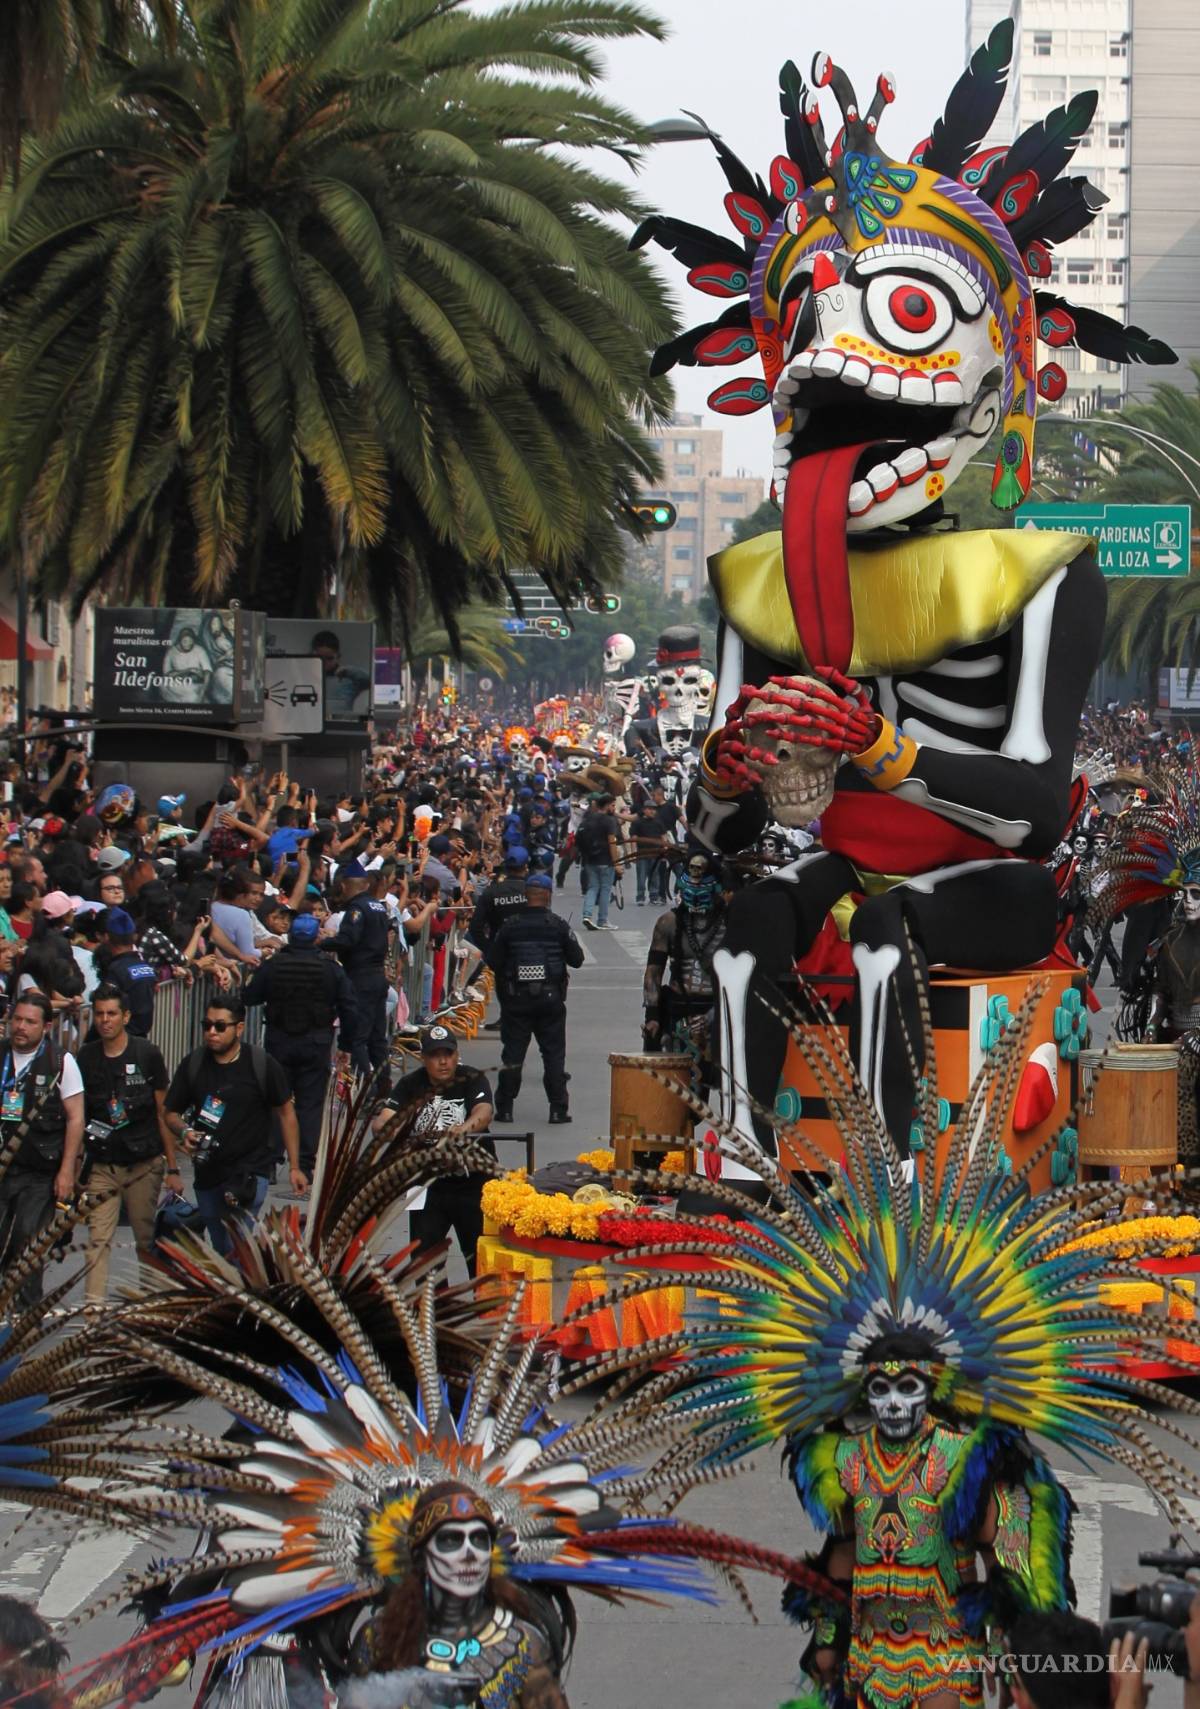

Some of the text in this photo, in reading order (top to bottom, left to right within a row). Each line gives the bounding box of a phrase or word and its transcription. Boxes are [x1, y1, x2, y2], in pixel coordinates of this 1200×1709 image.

[1093, 526, 1150, 544] CARDENAS
[1098, 551, 1149, 567] LA LOZA
[113, 626, 155, 635] Maestros
[113, 637, 160, 646] muralistas
[114, 652, 147, 668] San
[113, 671, 193, 691] Ildefonso
